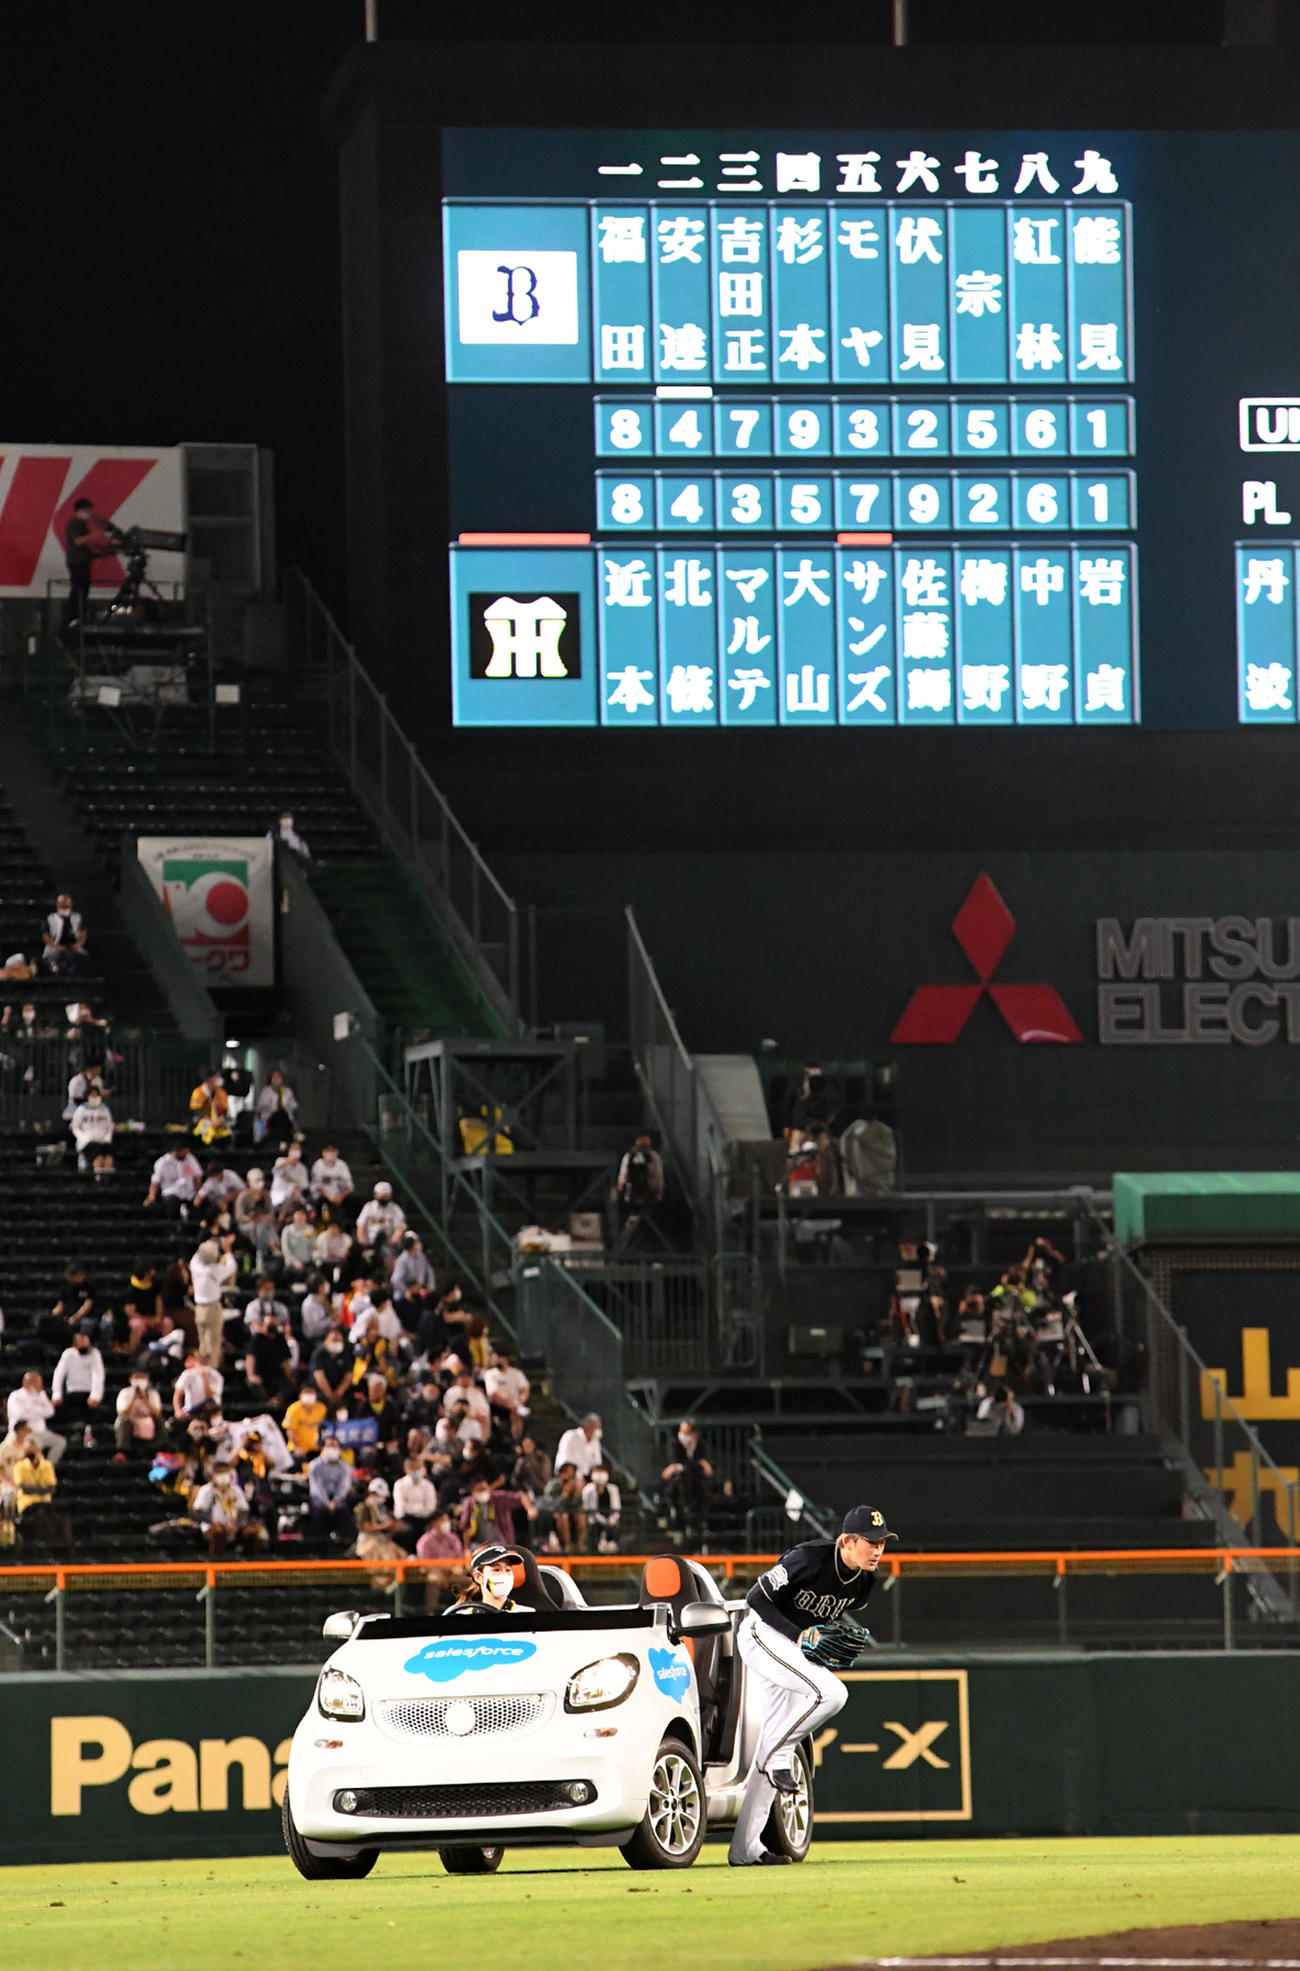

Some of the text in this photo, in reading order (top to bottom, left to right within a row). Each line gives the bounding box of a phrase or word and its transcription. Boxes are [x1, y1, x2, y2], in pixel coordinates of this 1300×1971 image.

[658, 154, 703, 187] 二
[718, 151, 762, 190] 三
[777, 153, 820, 192] 四
[837, 152, 881, 192] 五
[897, 152, 939, 192] 六
[955, 152, 998, 192] 七
[1015, 153, 1058, 193] 八
[1073, 151, 1118, 194] 九
[598, 217, 645, 369] 福田
[658, 217, 706, 370] 安達
[718, 217, 765, 370] 吉田正
[777, 218, 825, 370] 杉本
[838, 221, 882, 366] モヤ
[896, 218, 944, 370] 伏見
[956, 271, 1002, 316] 宗
[1014, 218, 1062, 369] 紅林
[1073, 217, 1121, 369] 能見
[610, 410, 1106, 448] 8 4 7 9 3 2 5 6 1
[1256, 407, 1300, 443] U
[612, 484, 1107, 523] 8 4 3 5 7 9 2 6 1
[1243, 481, 1291, 525] PL
[605, 560, 653, 712] 近本
[726, 568, 770, 709] マルテ
[784, 560, 830, 711] 大山
[844, 561, 890, 711] サンズ
[961, 560, 1009, 710] 梅野
[1021, 559, 1068, 710] 中野
[1079, 559, 1124, 710] 岩貞
[424, 1646, 524, 1660] salesforce
